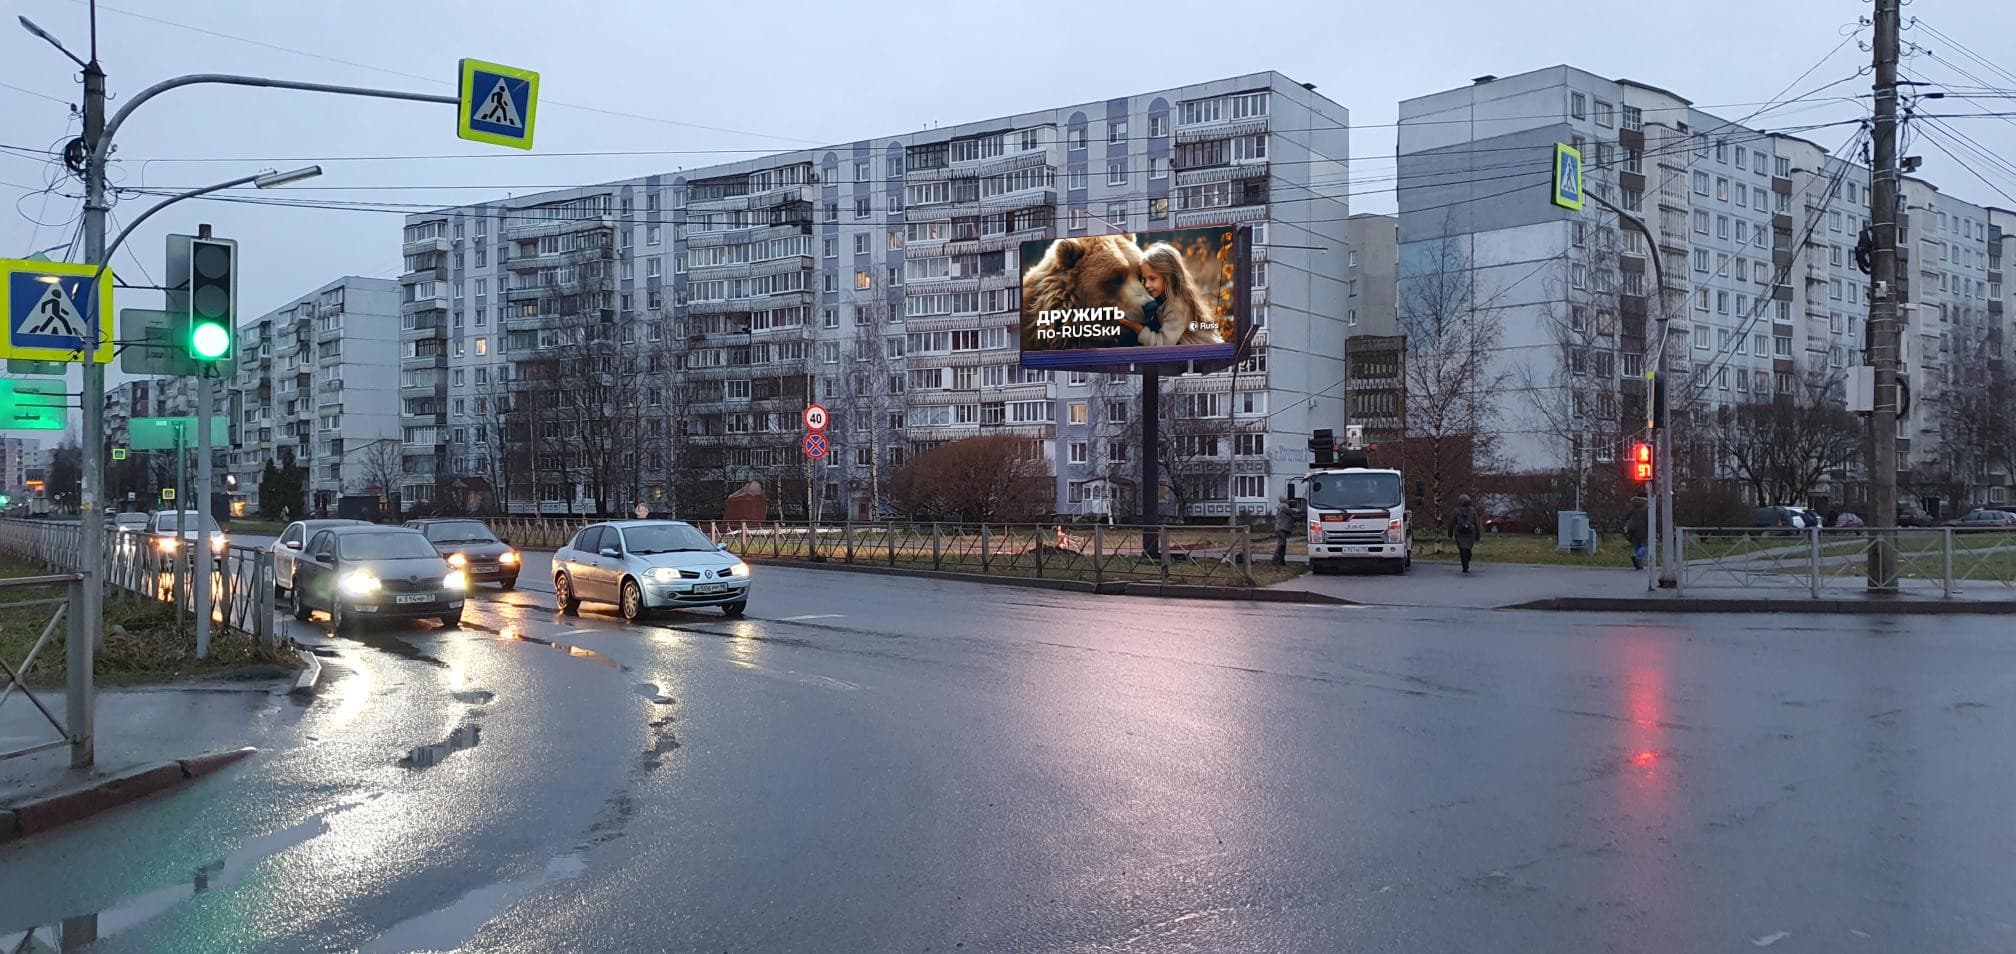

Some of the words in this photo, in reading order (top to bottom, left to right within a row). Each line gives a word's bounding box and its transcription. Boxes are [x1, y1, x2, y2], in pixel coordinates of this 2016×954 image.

[1036, 306, 1125, 326] ДРУЖИТЬ
[1037, 324, 1121, 340] по-RUSSки
[1200, 322, 1219, 330] Russ
[810, 413, 822, 424] 40
